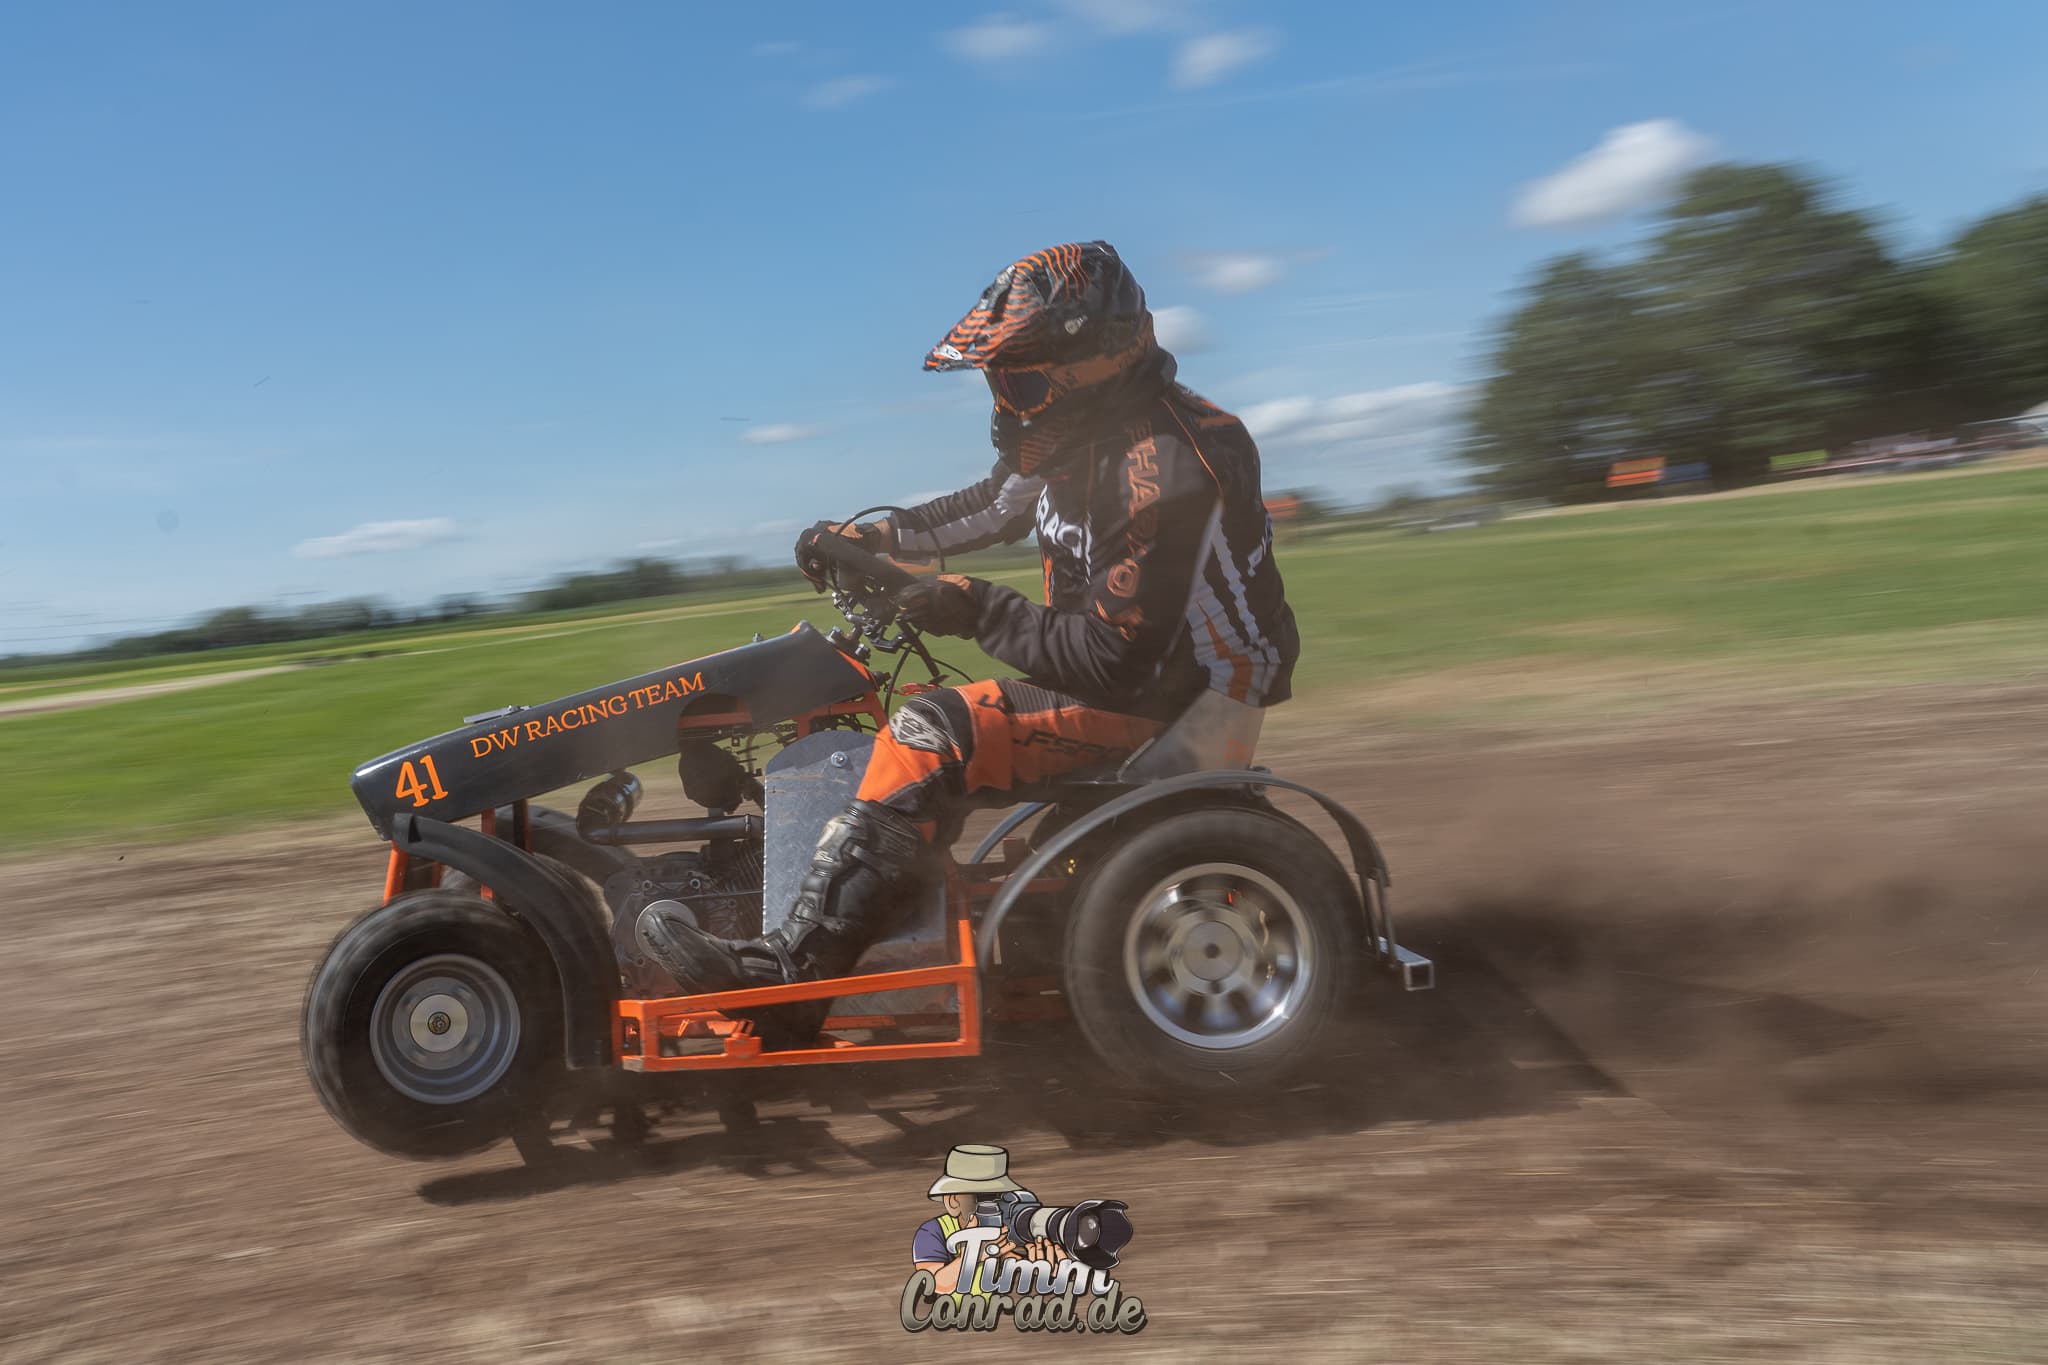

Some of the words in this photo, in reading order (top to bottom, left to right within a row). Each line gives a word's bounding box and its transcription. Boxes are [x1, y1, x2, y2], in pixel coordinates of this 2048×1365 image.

[470, 725, 521, 758] DW
[525, 695, 628, 742] RACING
[628, 671, 706, 710] TEAM
[394, 753, 449, 808] 41
